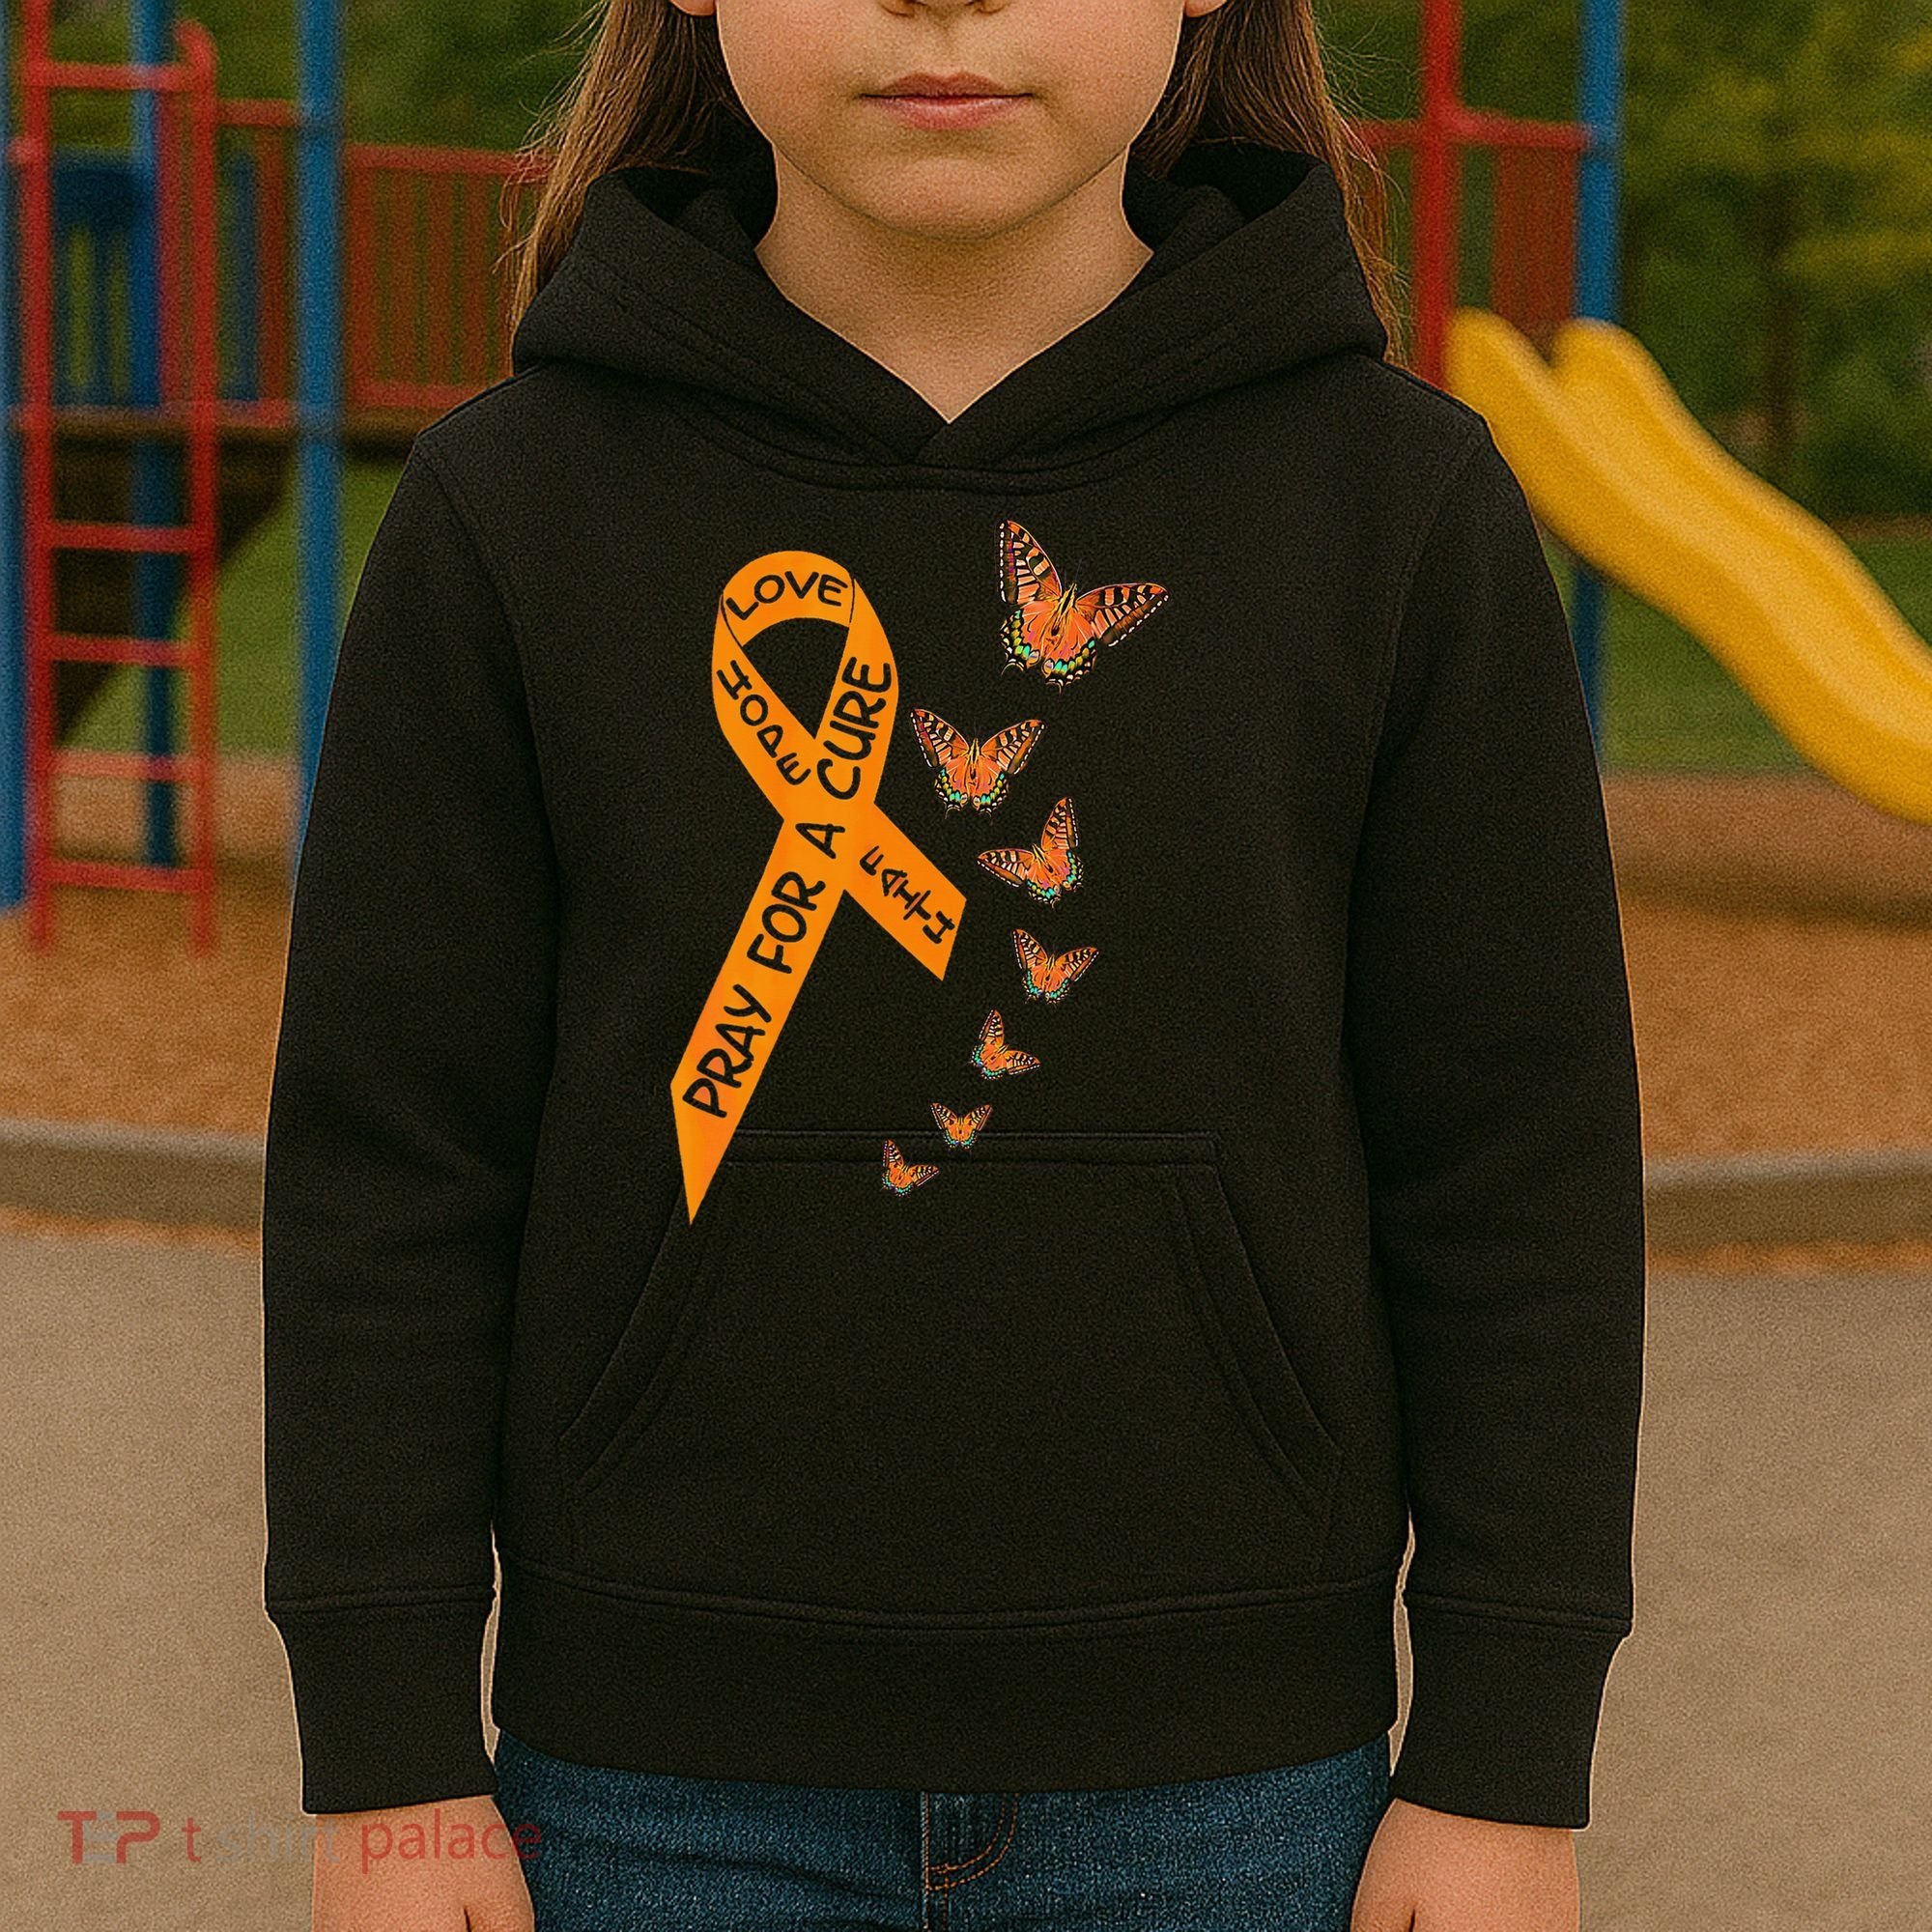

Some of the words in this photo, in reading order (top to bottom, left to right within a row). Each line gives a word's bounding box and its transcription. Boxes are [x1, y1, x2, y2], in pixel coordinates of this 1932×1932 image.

[725, 571, 848, 620] LOVE
[716, 660, 811, 785] HOPE
[816, 656, 893, 800] CURE
[795, 822, 846, 859] A
[747, 871, 826, 974] FOR
[859, 845, 955, 944] FAITH
[682, 983, 772, 1118] PRAY
